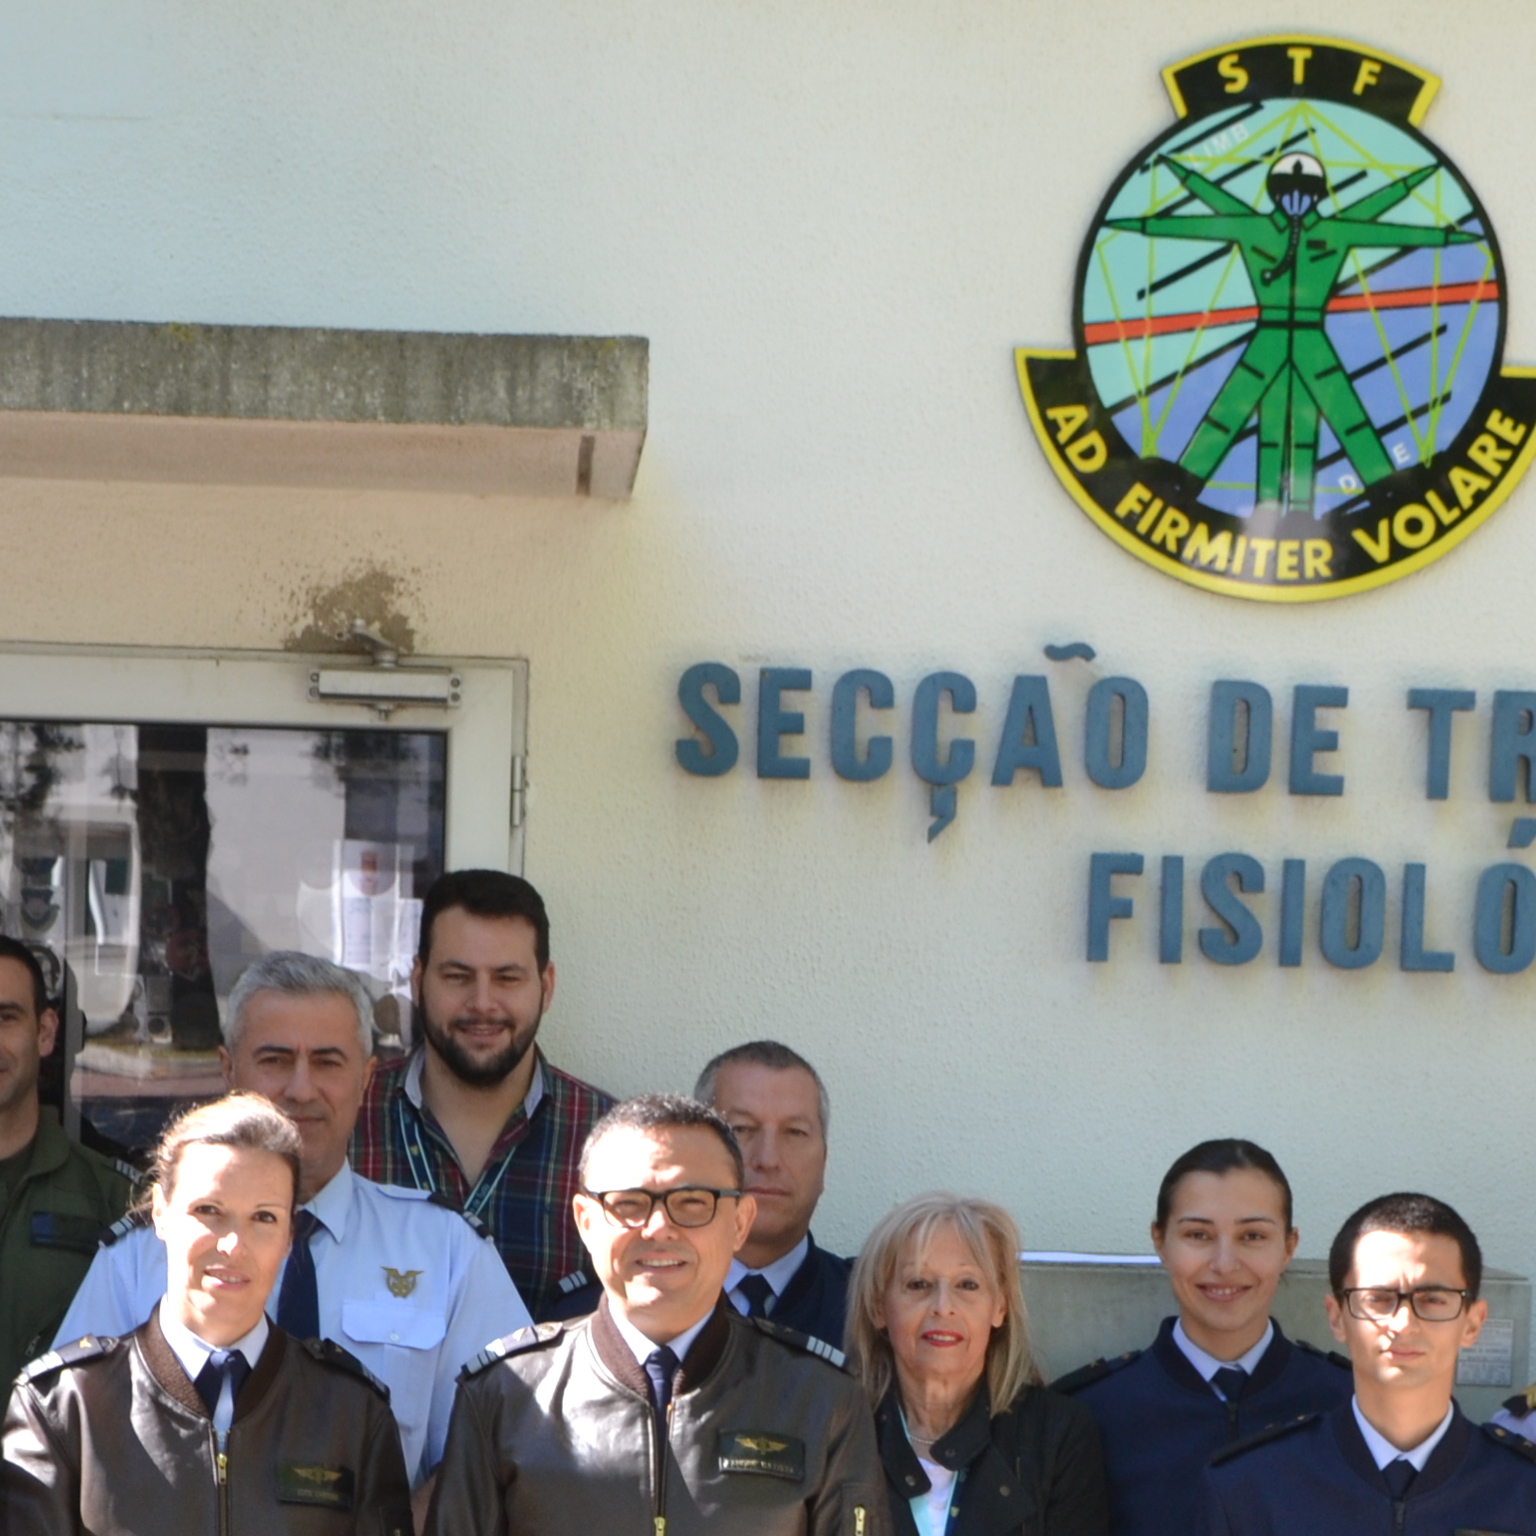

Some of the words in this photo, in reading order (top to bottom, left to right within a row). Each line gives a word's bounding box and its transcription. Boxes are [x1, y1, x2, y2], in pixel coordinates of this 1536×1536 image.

[1046, 402, 1108, 475] AD
[1114, 481, 1332, 580] FIRMITER
[1351, 408, 1527, 565] VOLARE
[674, 642, 1150, 844] SECÇÃO
[1205, 679, 1350, 797] DE
